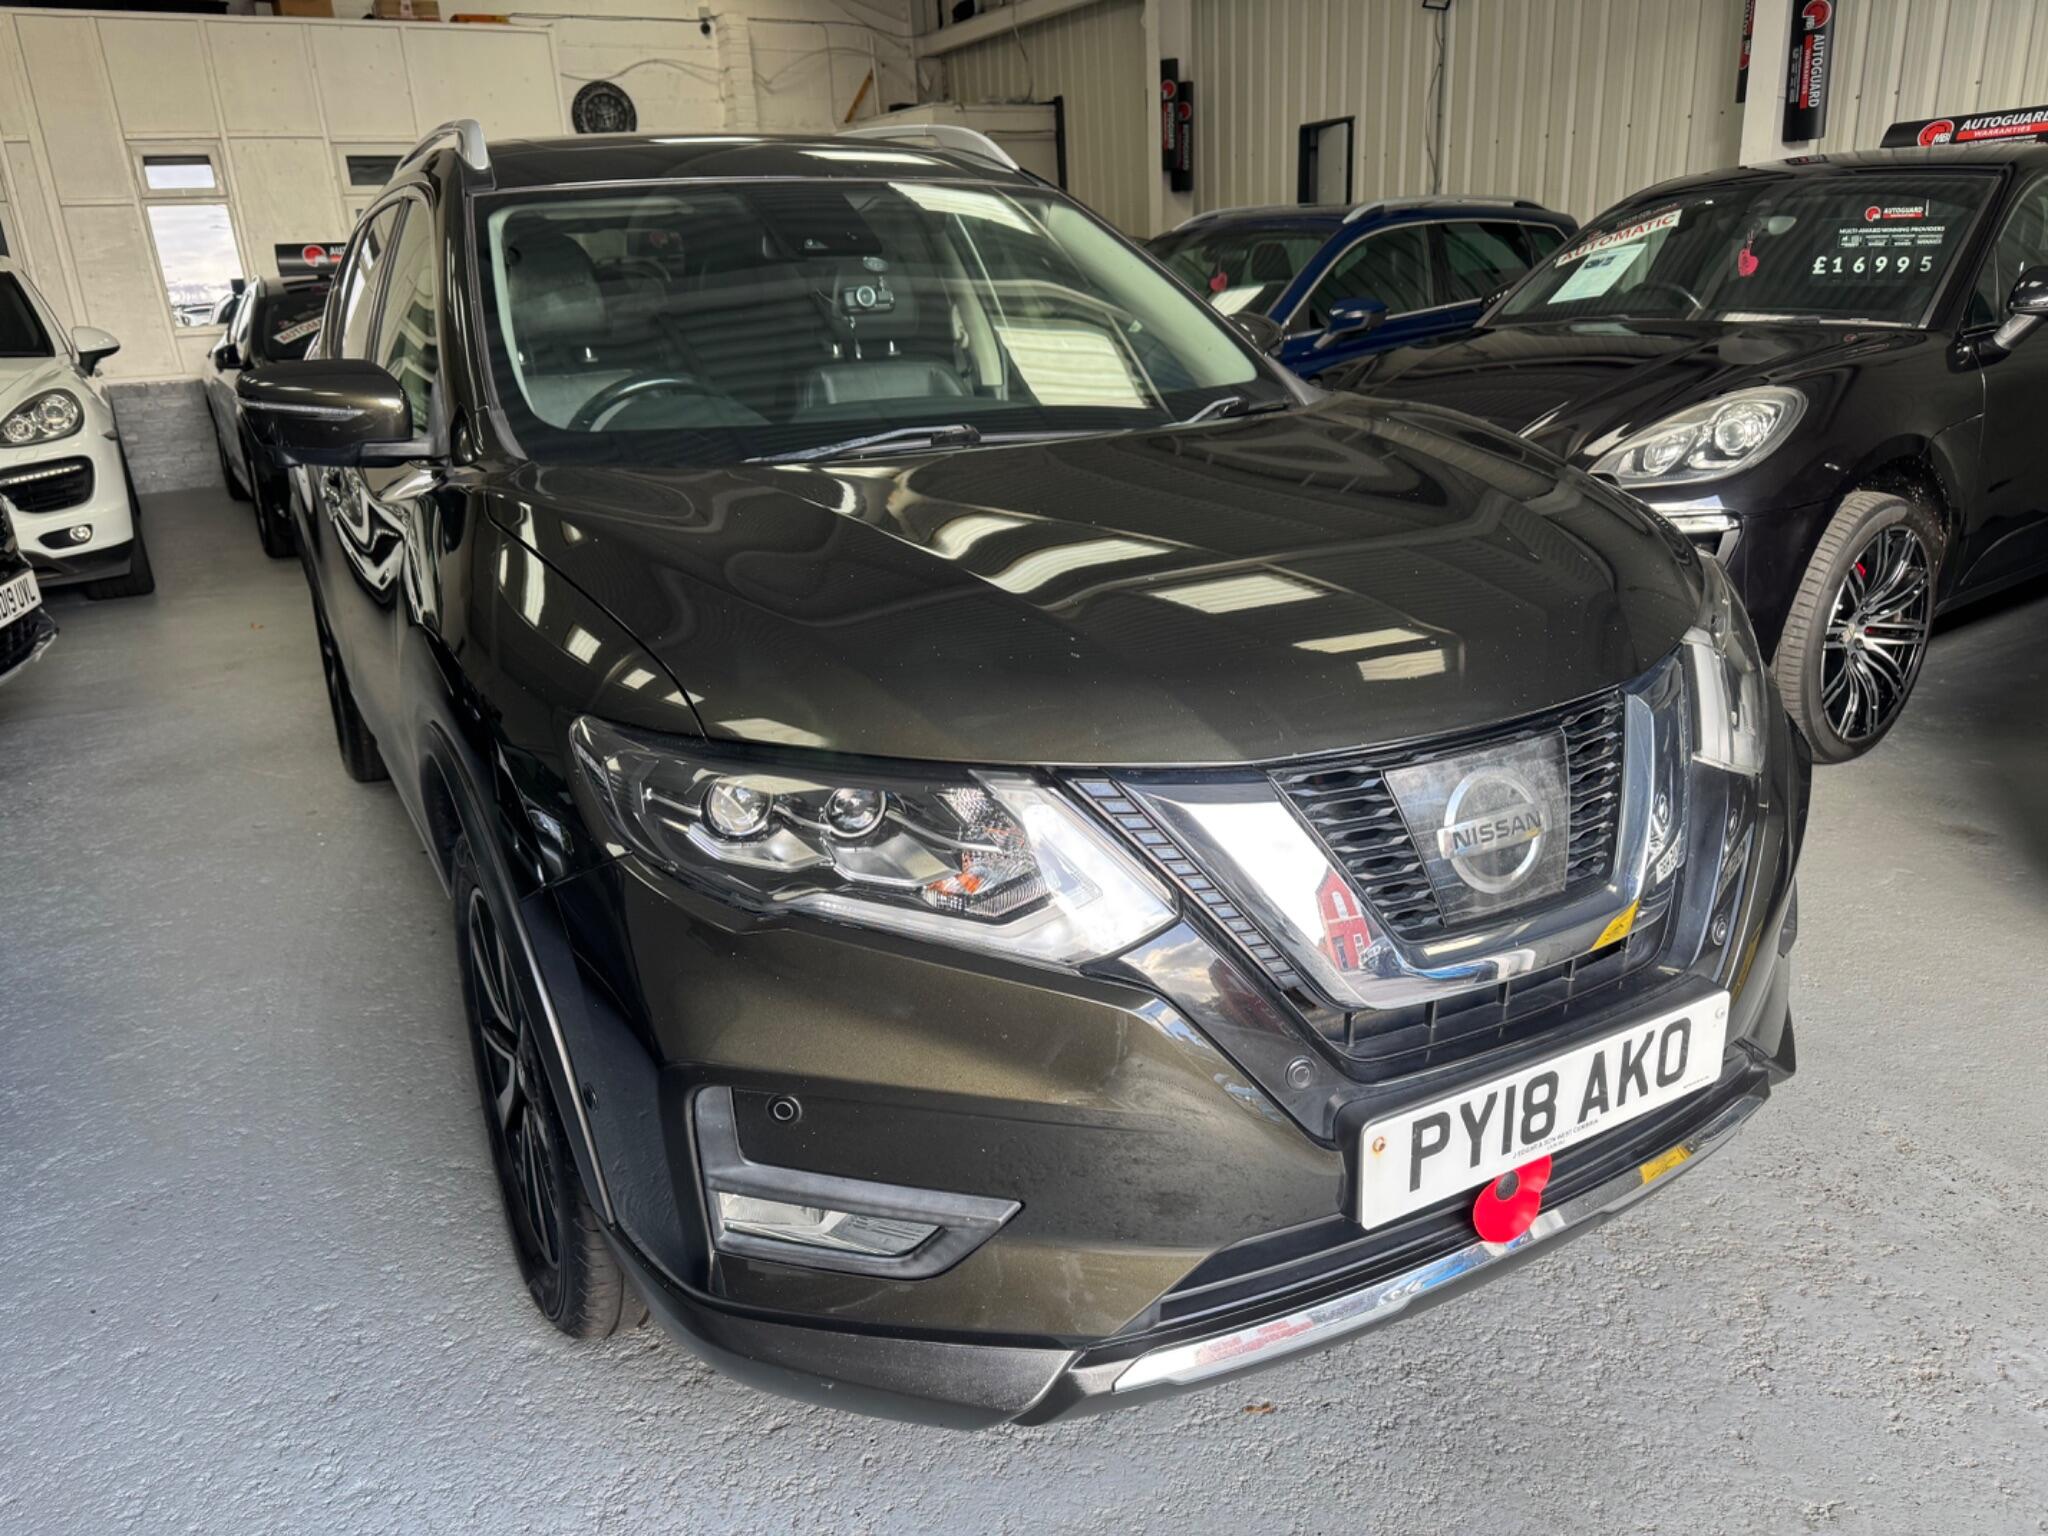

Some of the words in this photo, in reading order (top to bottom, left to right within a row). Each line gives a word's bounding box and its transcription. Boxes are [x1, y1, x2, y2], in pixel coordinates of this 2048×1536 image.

[1808, 34, 1825, 107] AUTOGUARD
[1974, 125, 2031, 137] WARRANTIES
[1560, 214, 1676, 260] AUTOMATIC
[1452, 811, 1542, 849] NISSAN
[1409, 1070, 1559, 1192] PY18
[1577, 1017, 1692, 1124] AKO
